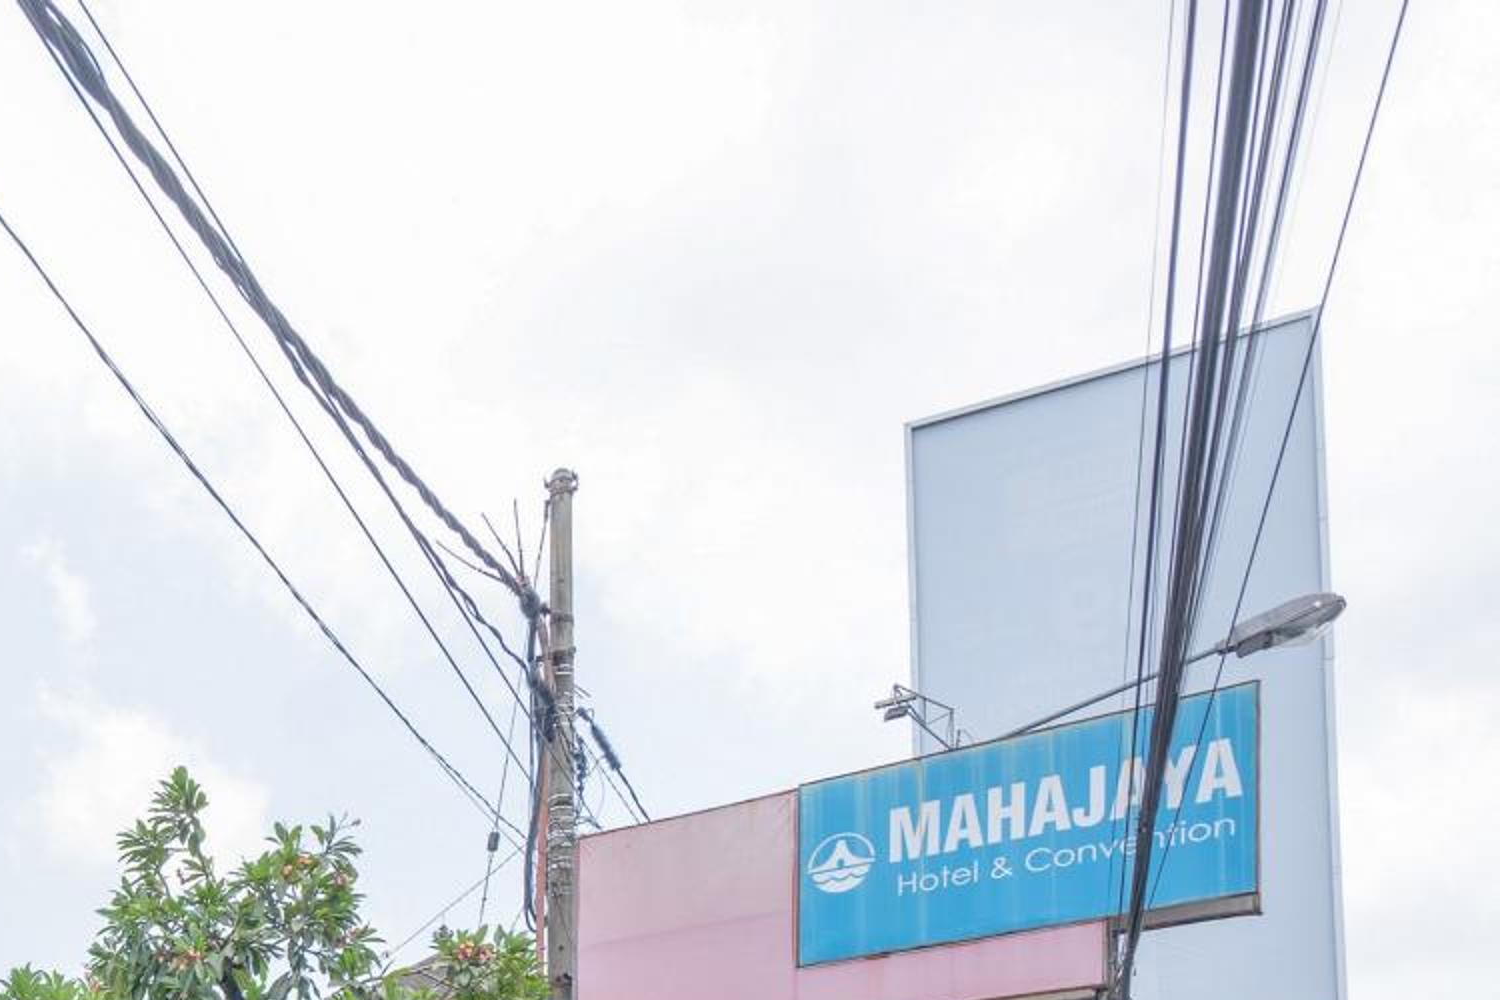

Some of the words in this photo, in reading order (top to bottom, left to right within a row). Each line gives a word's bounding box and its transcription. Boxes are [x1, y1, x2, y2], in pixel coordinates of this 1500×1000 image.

[889, 739, 1243, 863] MAHAJAYA
[897, 859, 980, 896] Hotel
[990, 856, 1013, 880] &
[1024, 818, 1236, 872] Convention
